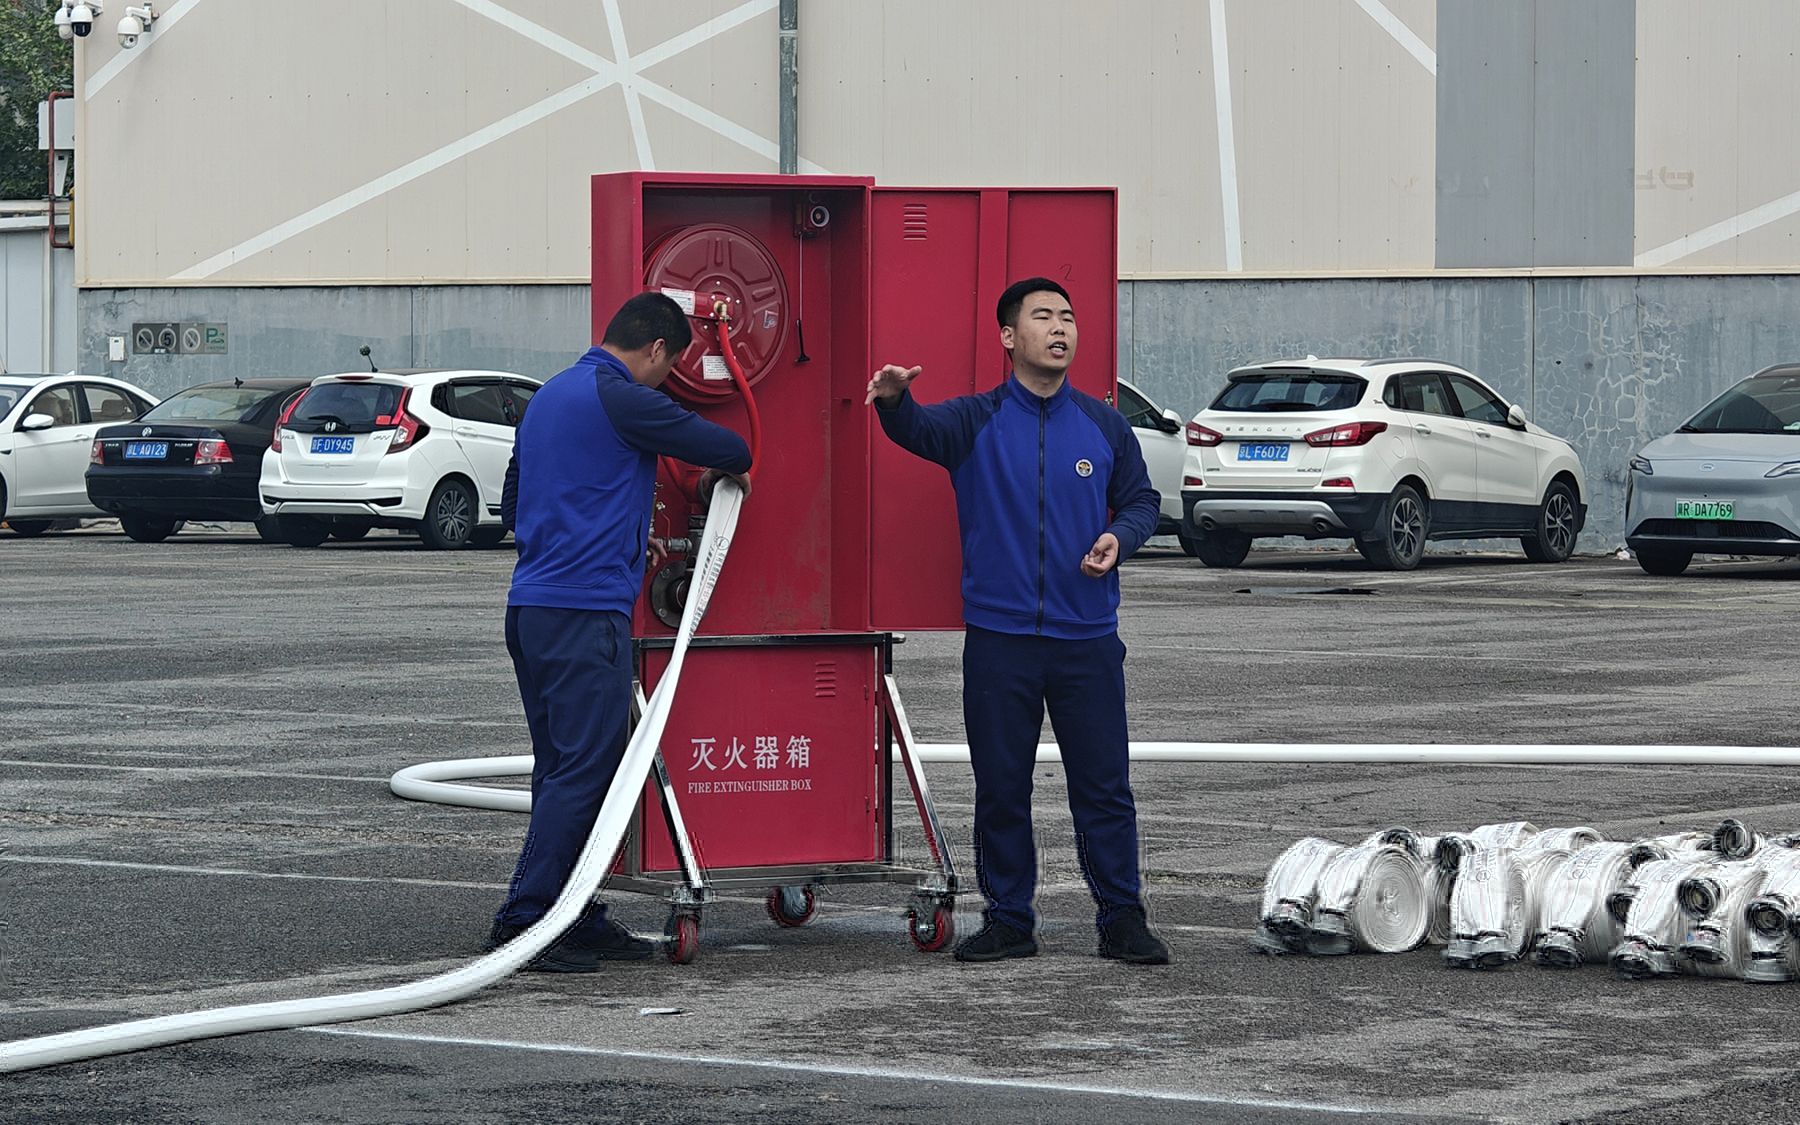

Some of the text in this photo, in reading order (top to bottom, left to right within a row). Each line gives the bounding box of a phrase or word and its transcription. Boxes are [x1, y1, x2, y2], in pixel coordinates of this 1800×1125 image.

[1059, 263, 1076, 282] 2
[164, 333, 172, 347] 5
[205, 327, 219, 344] P
[688, 734, 812, 772] 灭火器箱
[688, 778, 812, 794] FIRE EXTINGUISHER BOX
